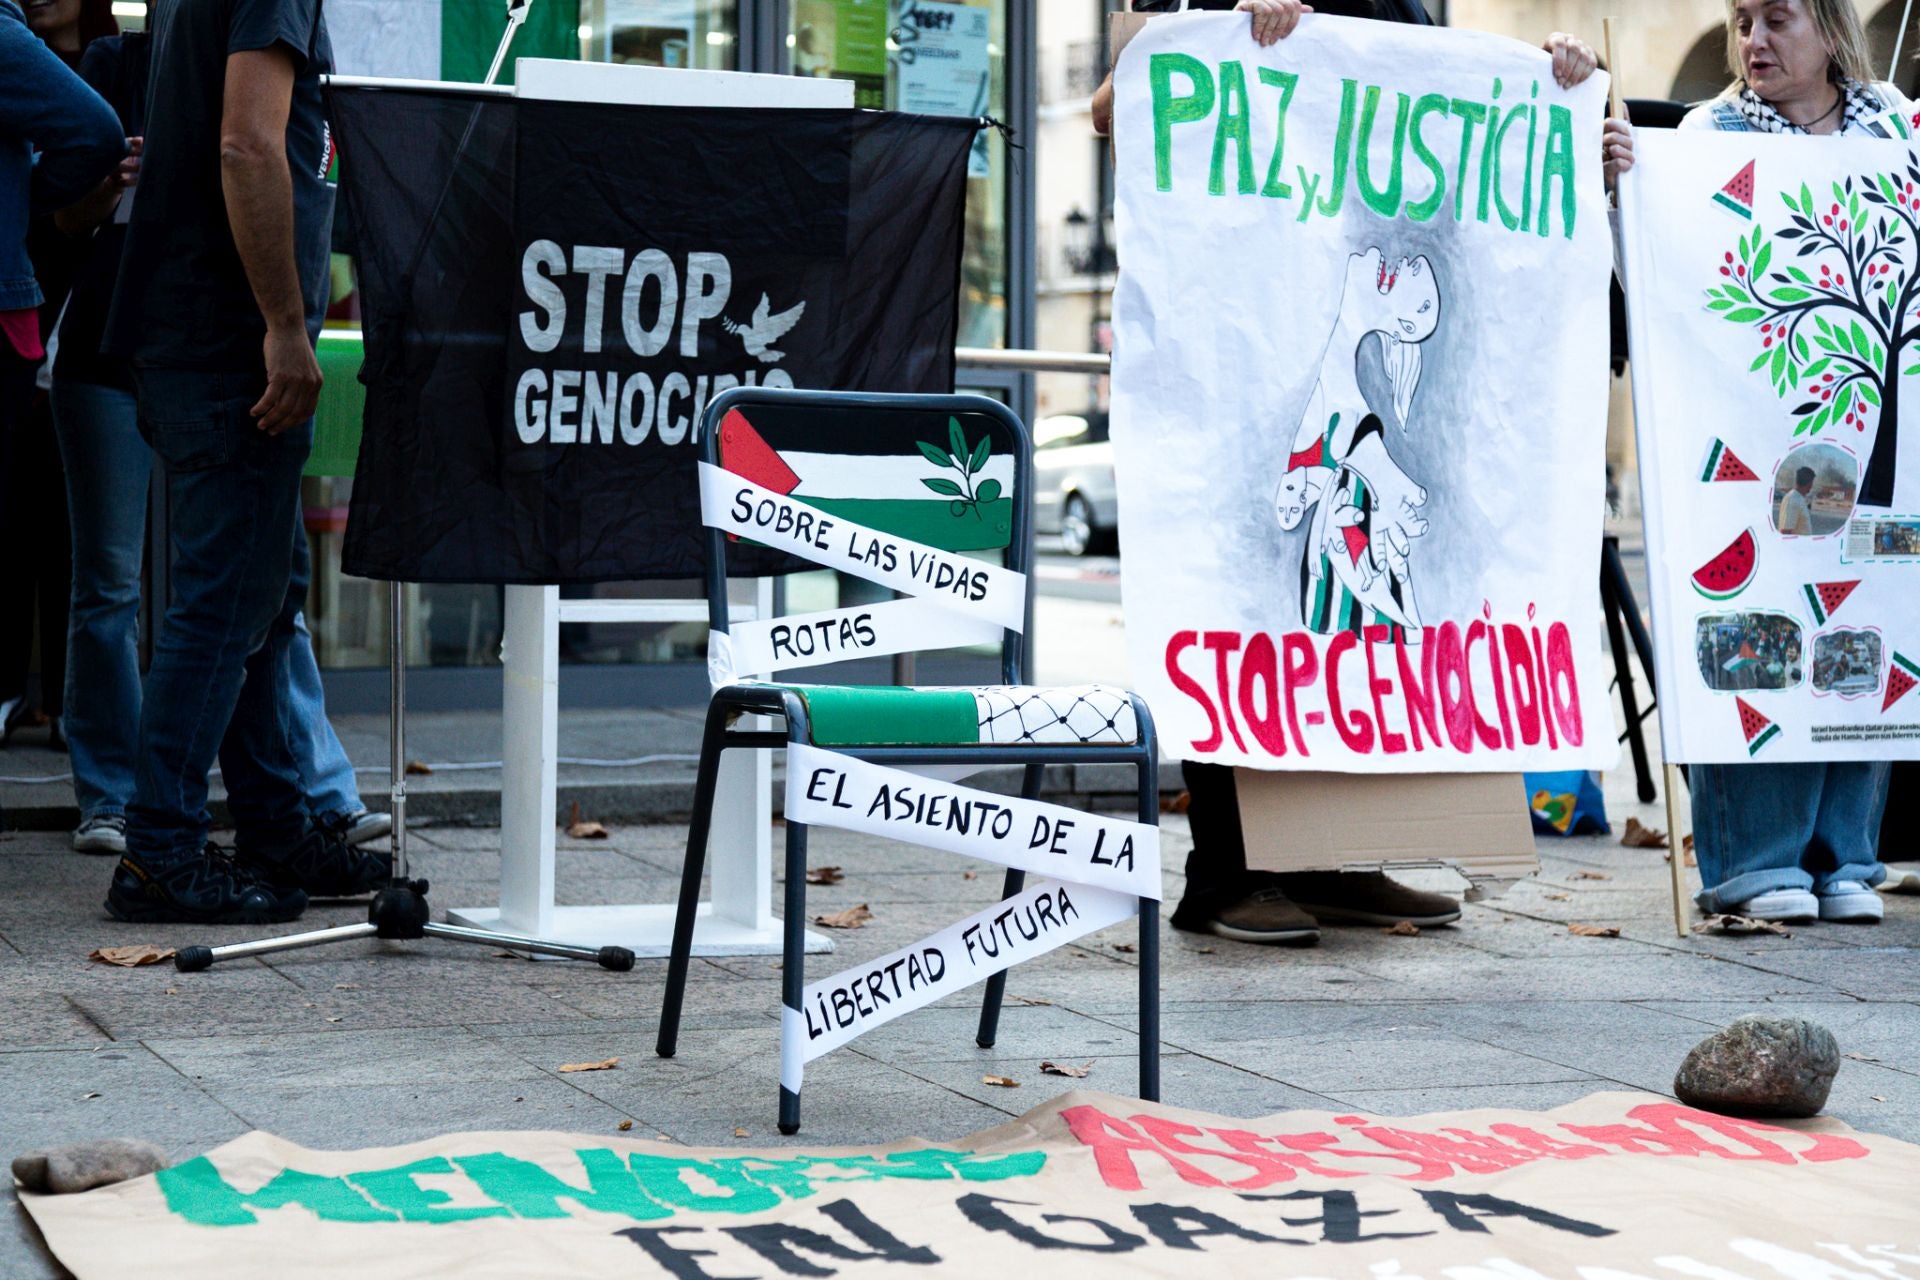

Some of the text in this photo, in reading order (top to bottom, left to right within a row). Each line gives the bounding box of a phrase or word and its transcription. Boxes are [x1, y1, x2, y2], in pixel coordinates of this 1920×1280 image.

[1150, 53, 1299, 199] PAZ
[1317, 77, 1577, 240] JUSTICIA
[519, 239, 732, 357] STOP
[514, 368, 794, 446] GENOCI
[731, 488, 989, 601] SOBRE LAS VIDAS
[770, 614, 877, 660] ROTAS
[806, 768, 1135, 872] EL ASIENTO DE LA
[804, 887, 1080, 1041] LIBERTAD FUTURA
[611, 1186, 1620, 1280] EN GAZA
